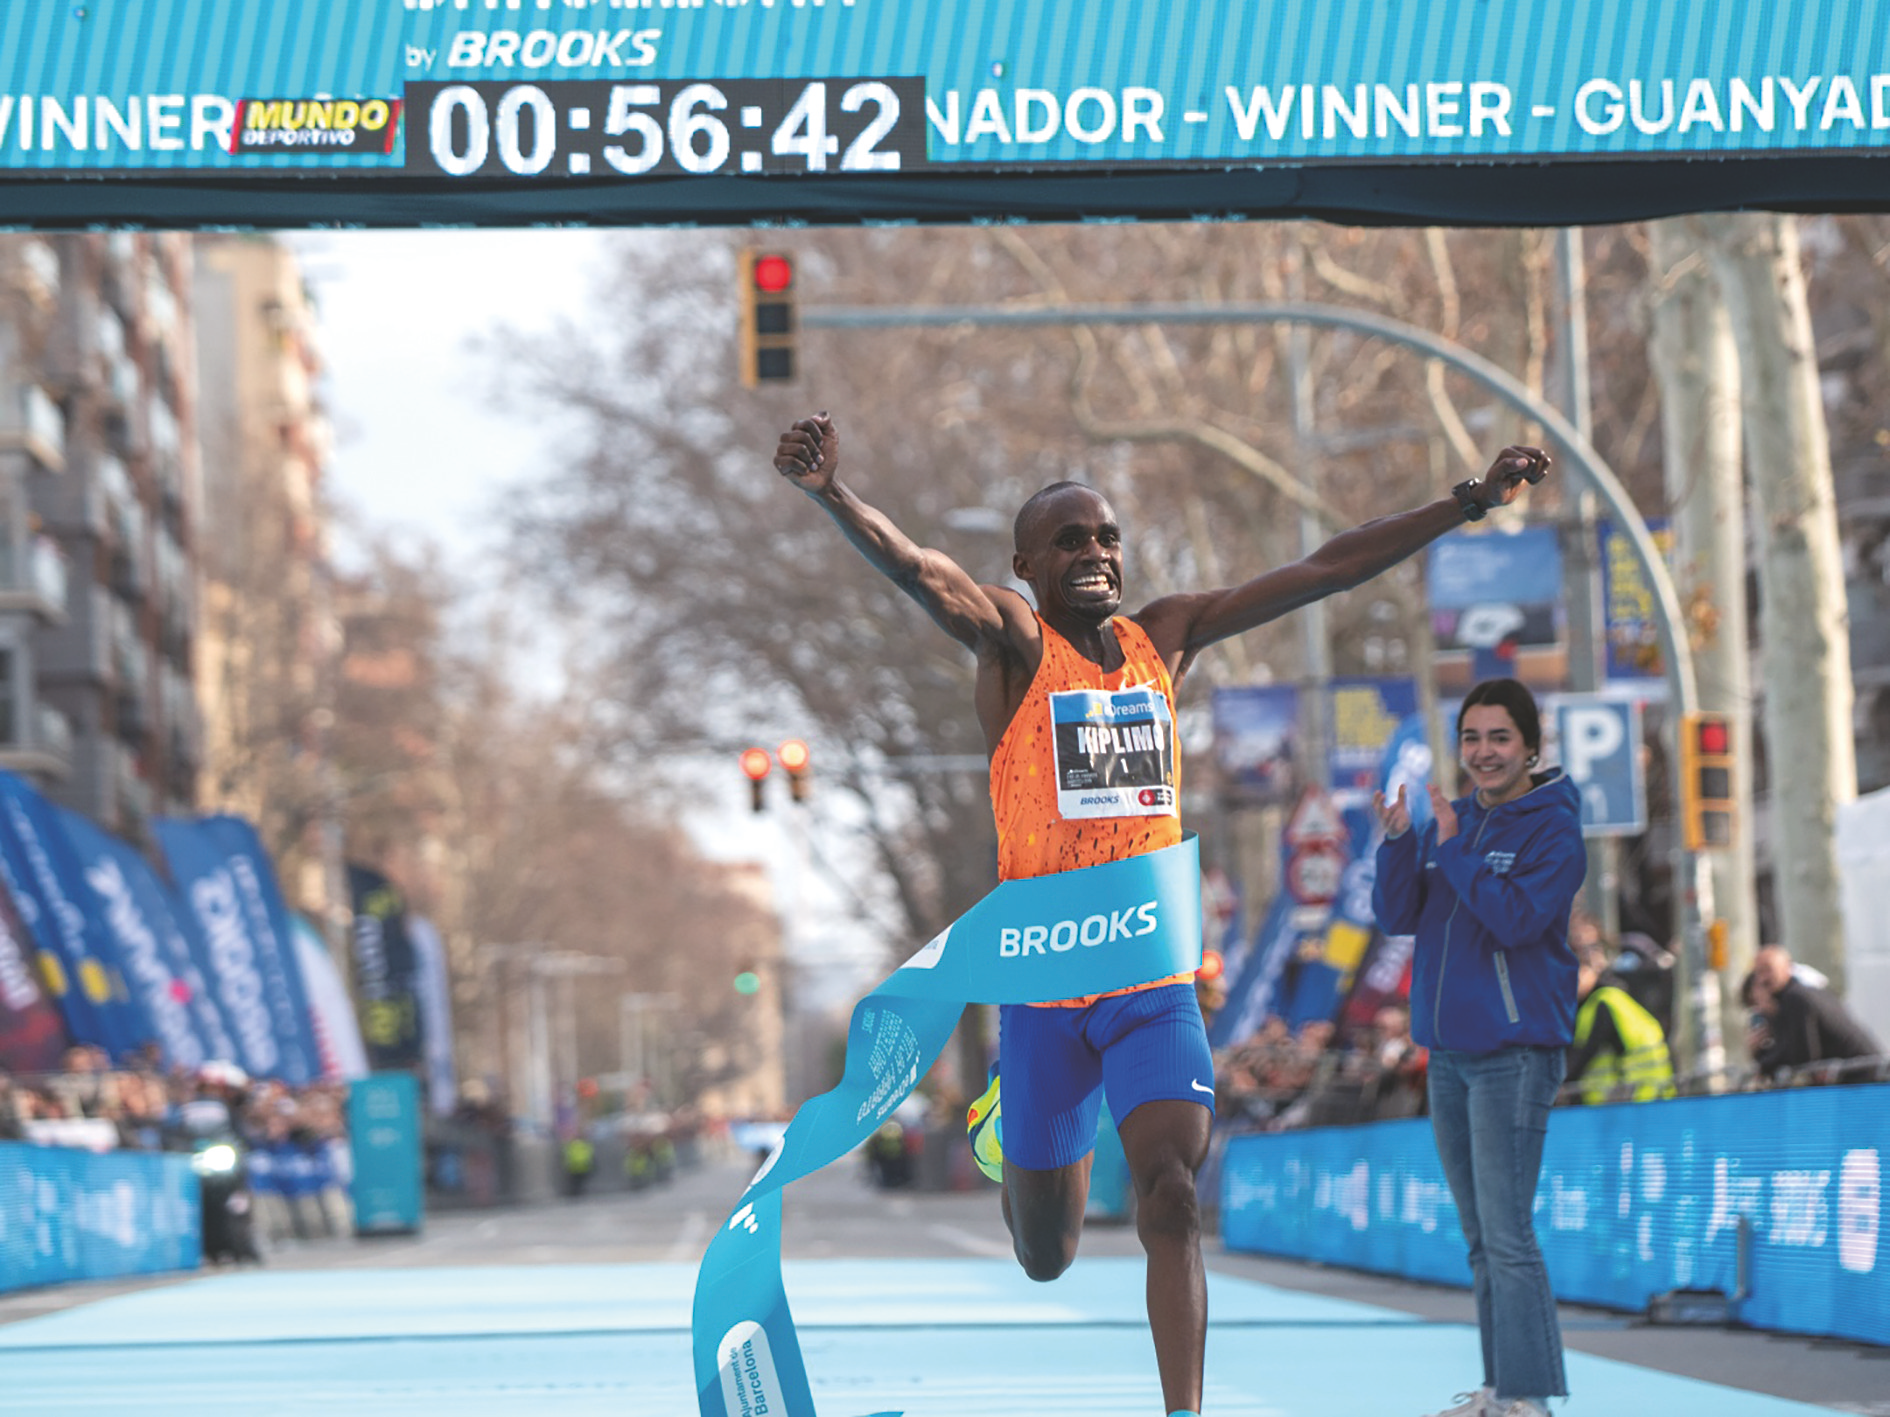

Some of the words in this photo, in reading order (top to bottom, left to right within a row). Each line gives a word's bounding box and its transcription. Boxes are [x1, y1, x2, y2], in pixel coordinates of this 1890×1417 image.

[405, 44, 436, 71] by
[448, 28, 662, 68] BROOKS
[0, 95, 235, 152] INNER
[246, 100, 390, 131] MUNDO
[427, 80, 902, 177] 00:56:42
[1184, 110, 1207, 122] -
[1225, 81, 1511, 141] WINNER
[1532, 105, 1552, 117] -
[243, 128, 356, 146] DEPORTIVO
[1077, 724, 1165, 754] KIPLIMO
[1565, 707, 1624, 783] P
[1120, 758, 1129, 774] 1
[1080, 796, 1119, 805] BROOKS
[999, 901, 1158, 958] BROOKS
[742, 1339, 769, 1416] Barcelona
